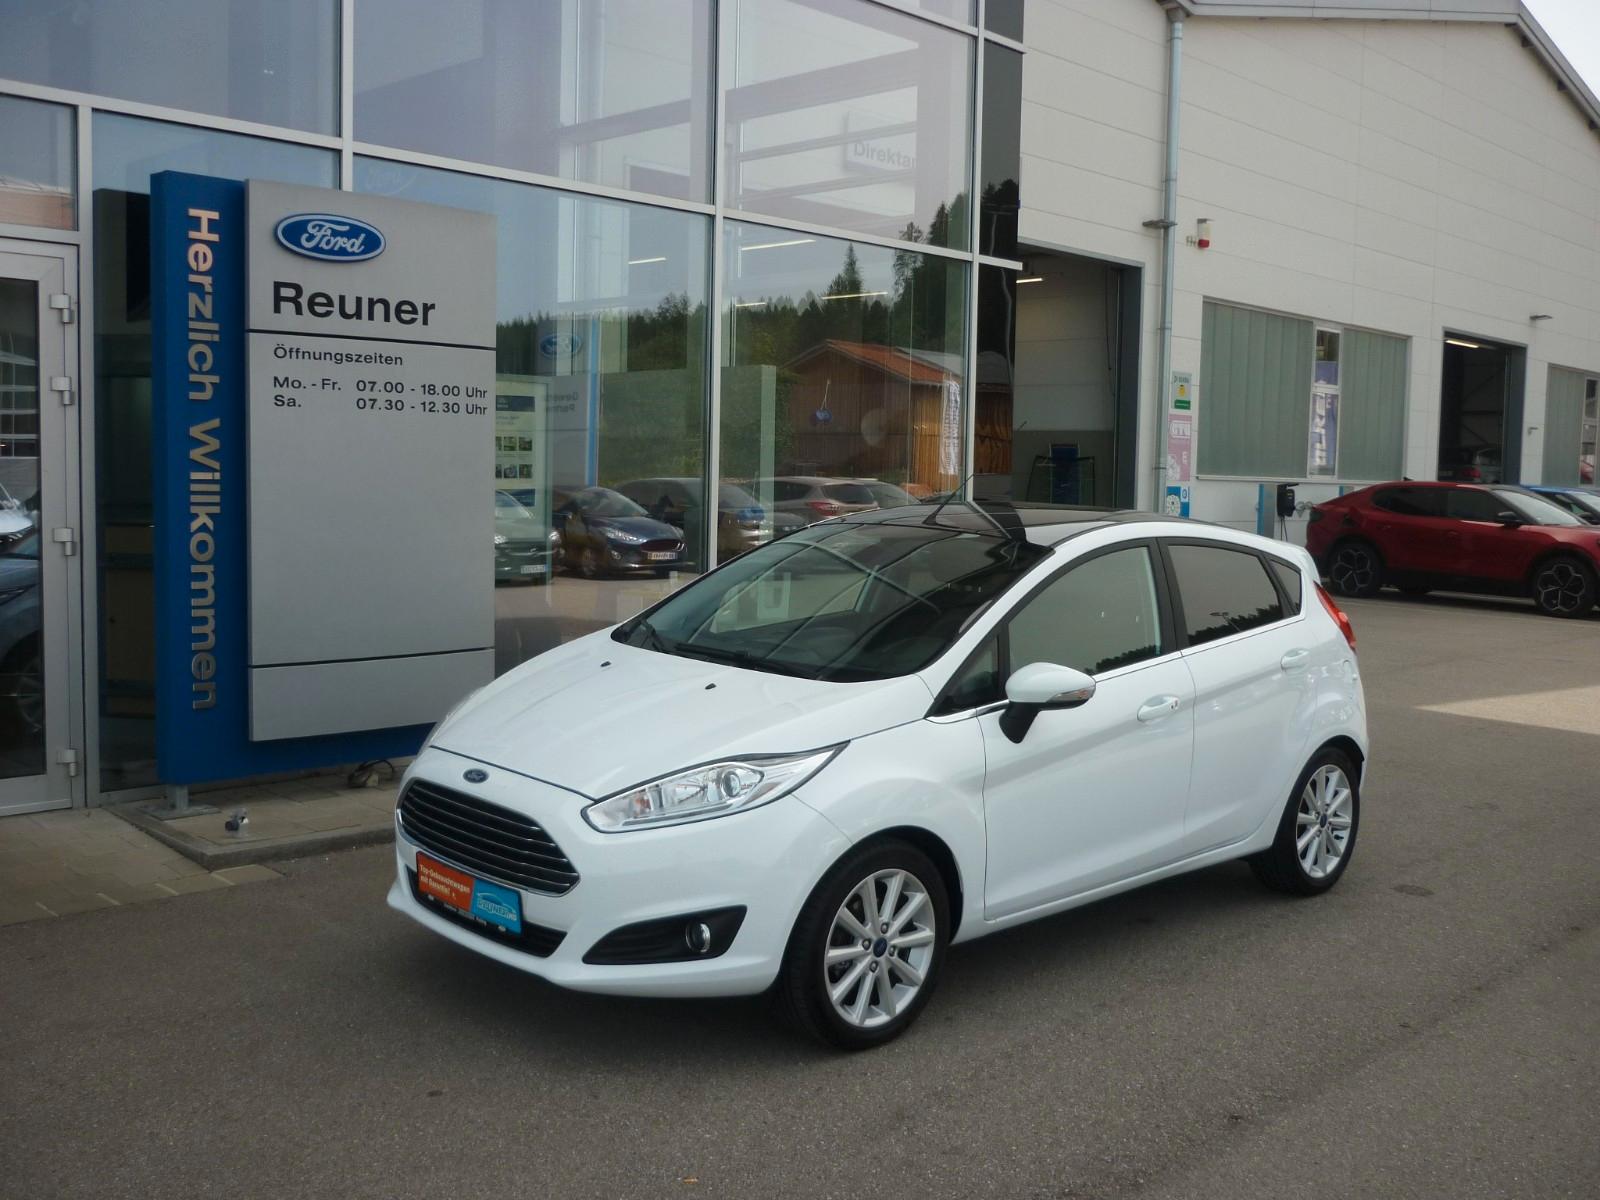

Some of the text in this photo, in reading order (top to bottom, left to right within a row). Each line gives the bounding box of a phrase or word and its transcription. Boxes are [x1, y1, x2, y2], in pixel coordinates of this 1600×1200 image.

[299, 219, 366, 254] Ford
[273, 281, 436, 326] Reuner
[273, 344, 403, 366] Öffnungszeiten
[273, 376, 307, 389] Mo.
[321, 378, 342, 391] Fr.
[356, 380, 404, 394] 07.00
[420, 384, 460, 397] 18.00
[465, 386, 488, 399] Uhr
[273, 395, 302, 408] Sa.
[356, 398, 404, 411] 07.30
[420, 401, 460, 414] 12.30
[465, 403, 488, 416] Uhr
[187, 208, 221, 710] Herzlich Willkommen
